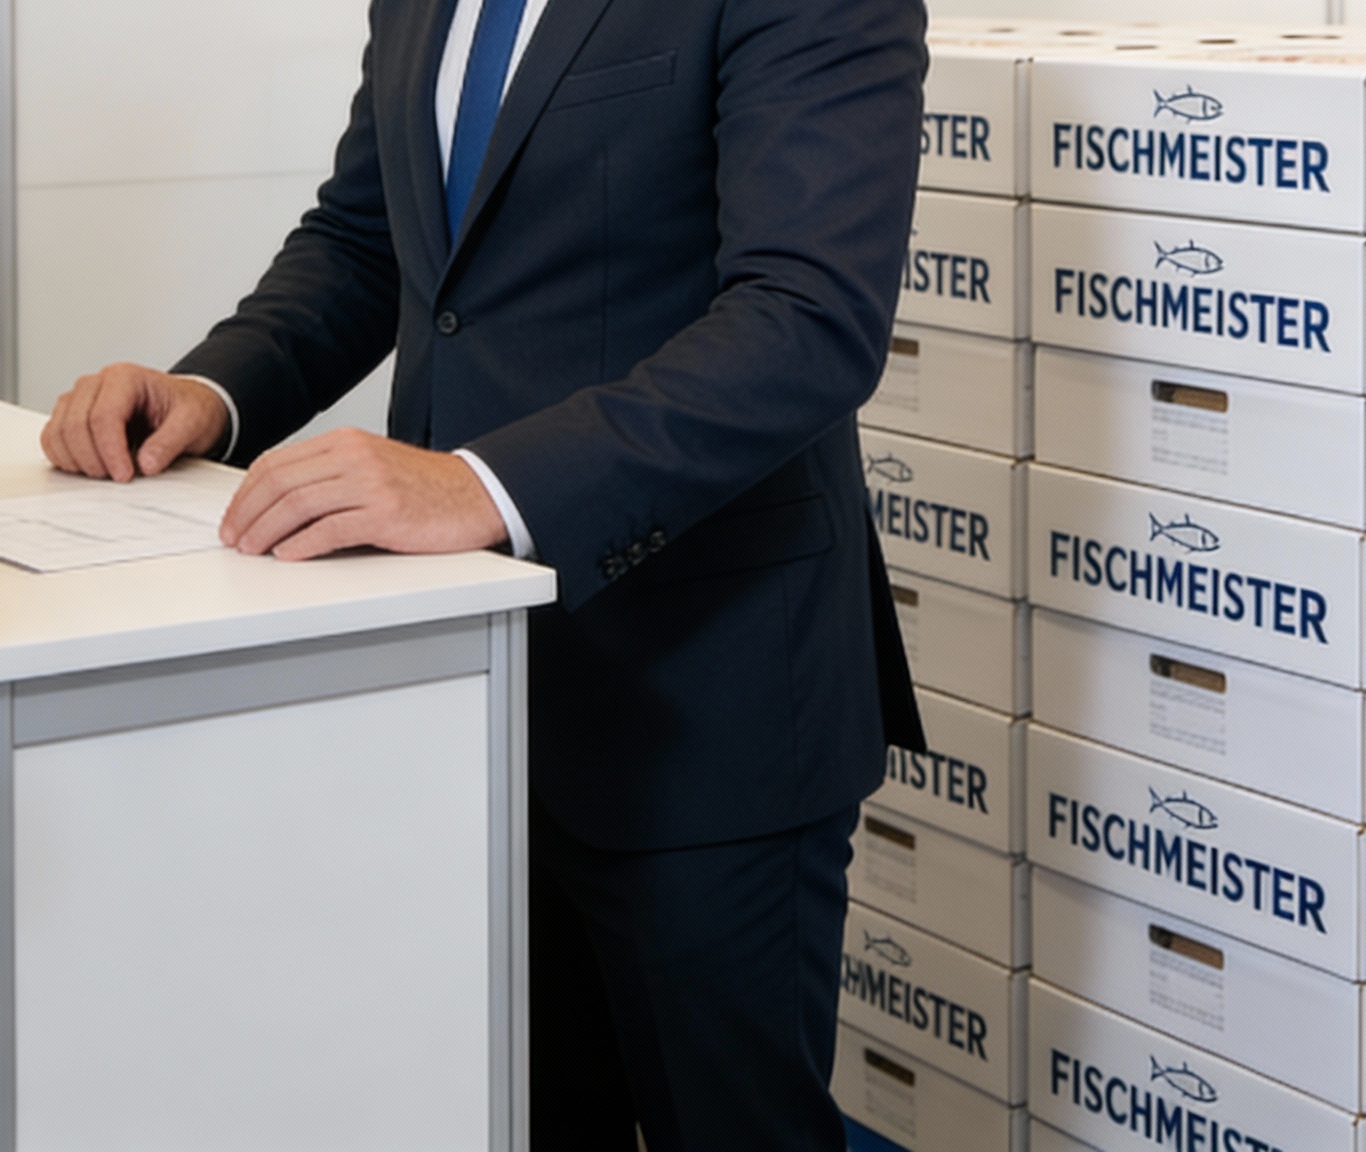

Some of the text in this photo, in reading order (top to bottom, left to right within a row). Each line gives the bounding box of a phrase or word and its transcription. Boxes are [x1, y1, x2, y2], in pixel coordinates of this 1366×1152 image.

[1053, 122, 1331, 193] FISCHMEISTER
[1054, 267, 1332, 353] FISCHMEISTER
[1049, 530, 1329, 645] FISCHMEISTER
[1048, 791, 1328, 934] FISCHMEISTER
